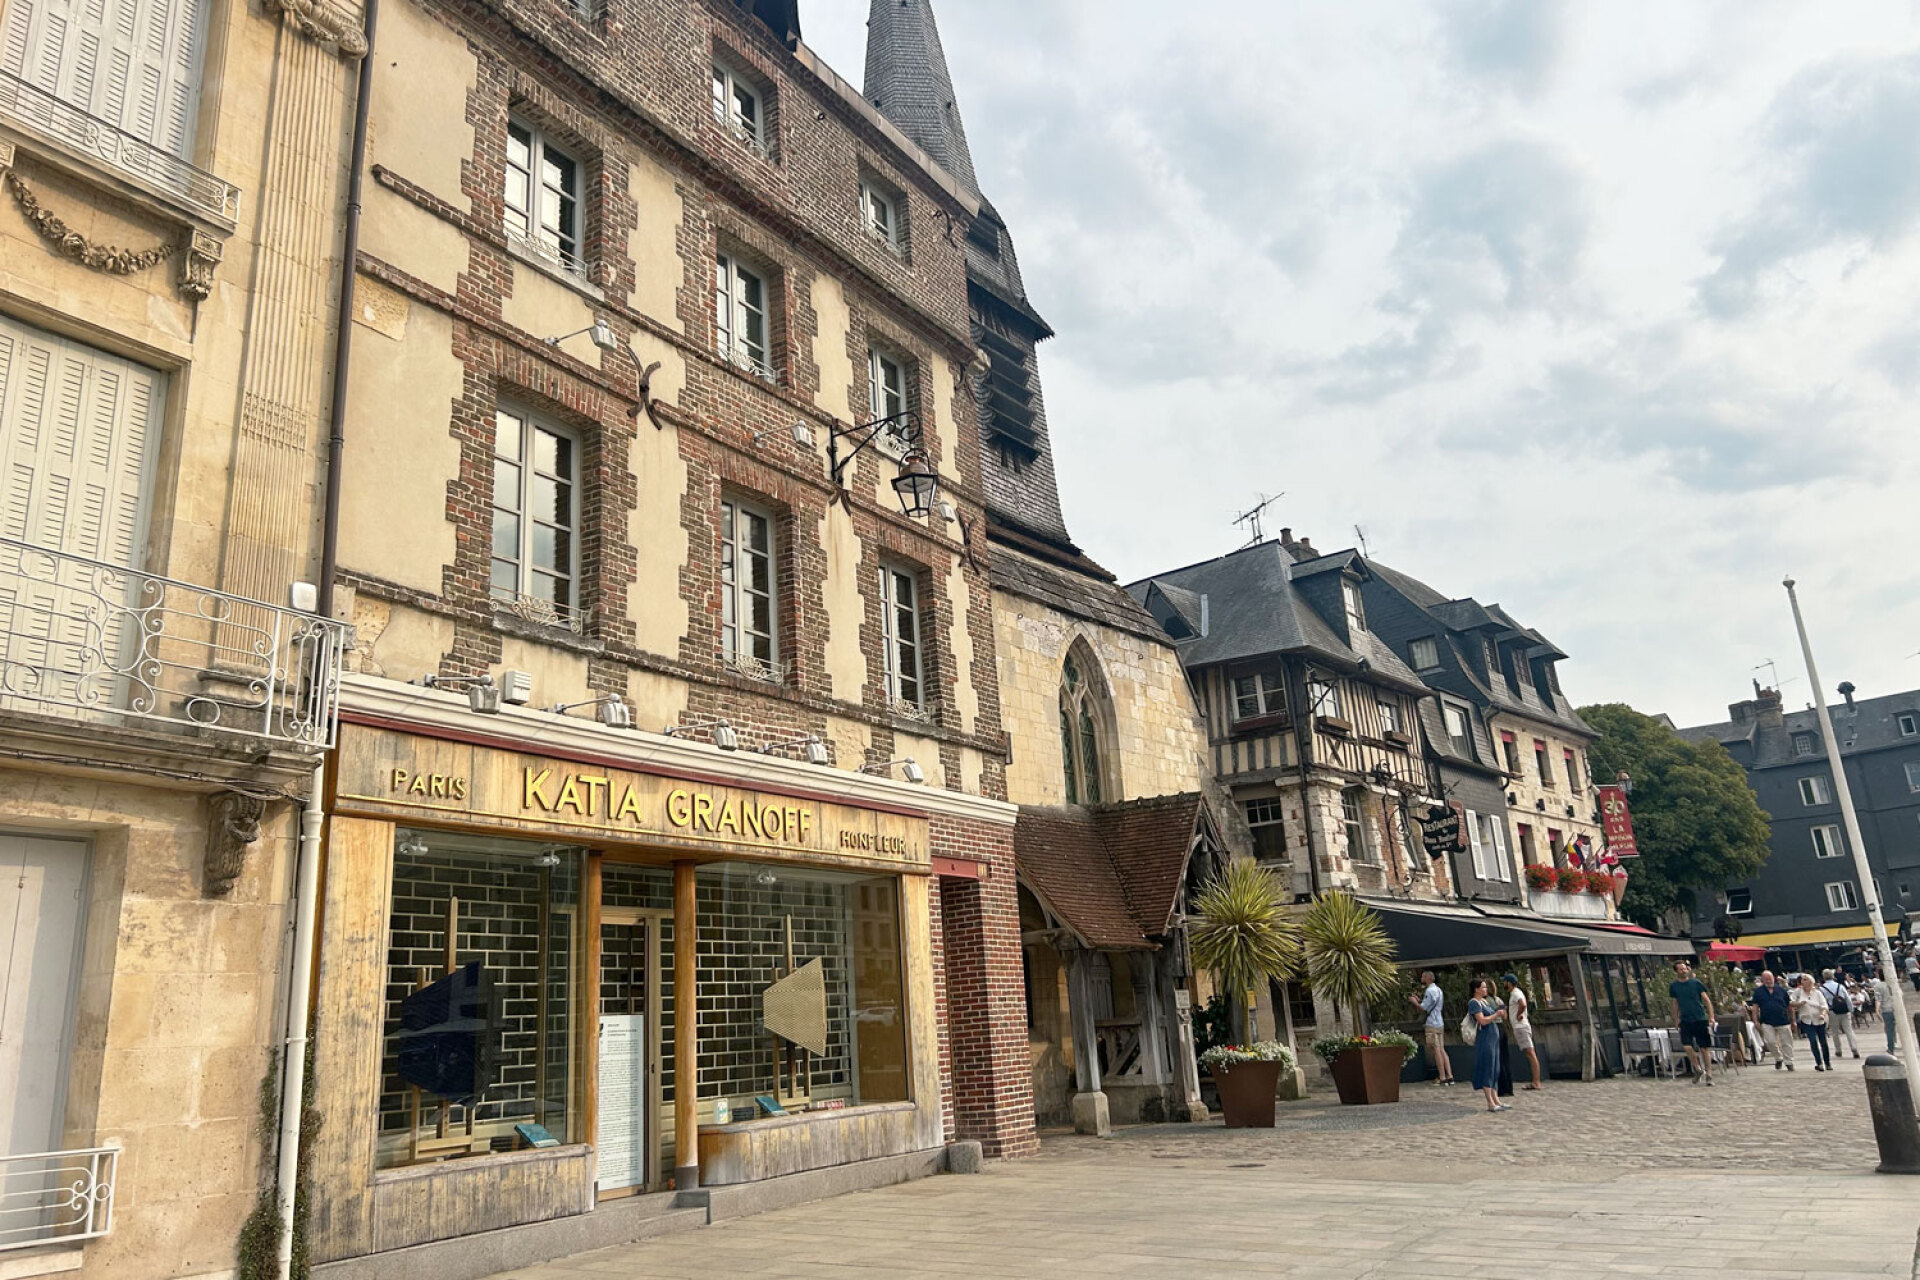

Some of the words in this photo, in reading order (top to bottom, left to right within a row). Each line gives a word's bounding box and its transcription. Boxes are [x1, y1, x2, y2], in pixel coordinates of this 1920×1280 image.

[393, 768, 466, 799] PARIS
[523, 766, 642, 823] KATIA
[667, 789, 811, 842] GRANOFF
[840, 830, 905, 854] HONFLEUR
